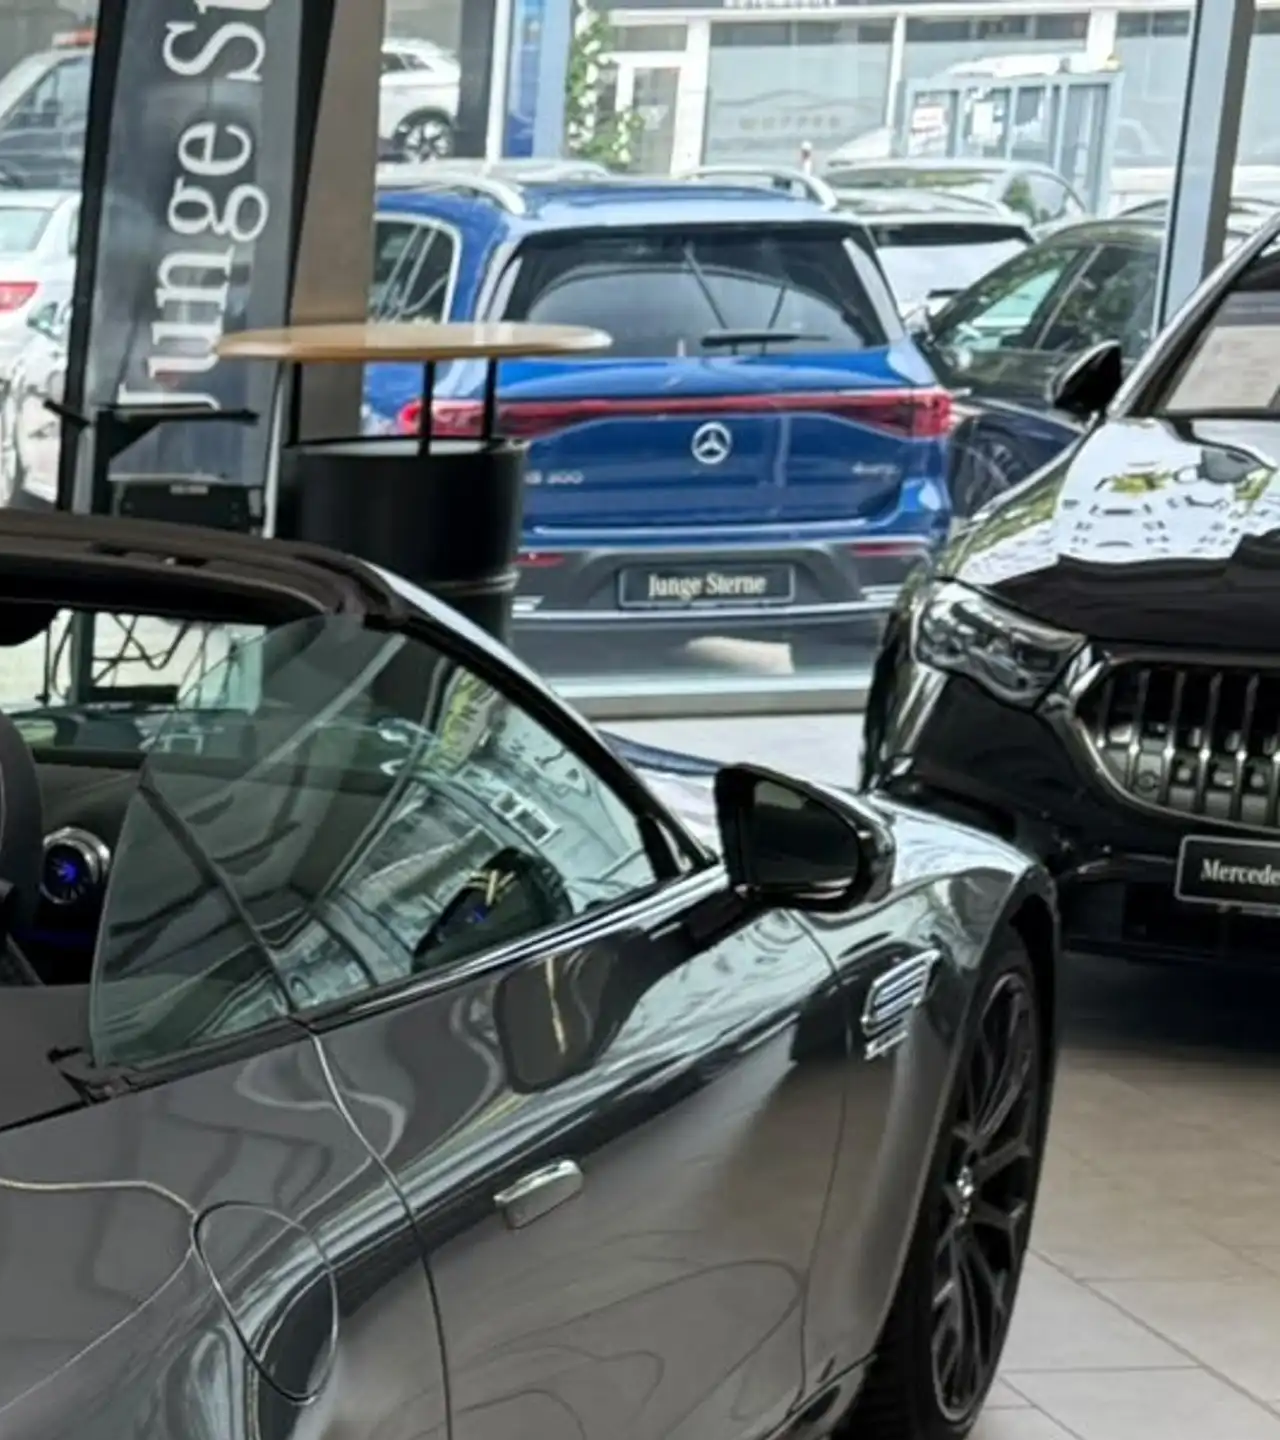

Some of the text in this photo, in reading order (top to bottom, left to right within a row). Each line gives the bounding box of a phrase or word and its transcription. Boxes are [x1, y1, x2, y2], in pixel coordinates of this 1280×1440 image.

[116, 121, 269, 411] Junge
[647, 571, 768, 597] Junge Sterne
